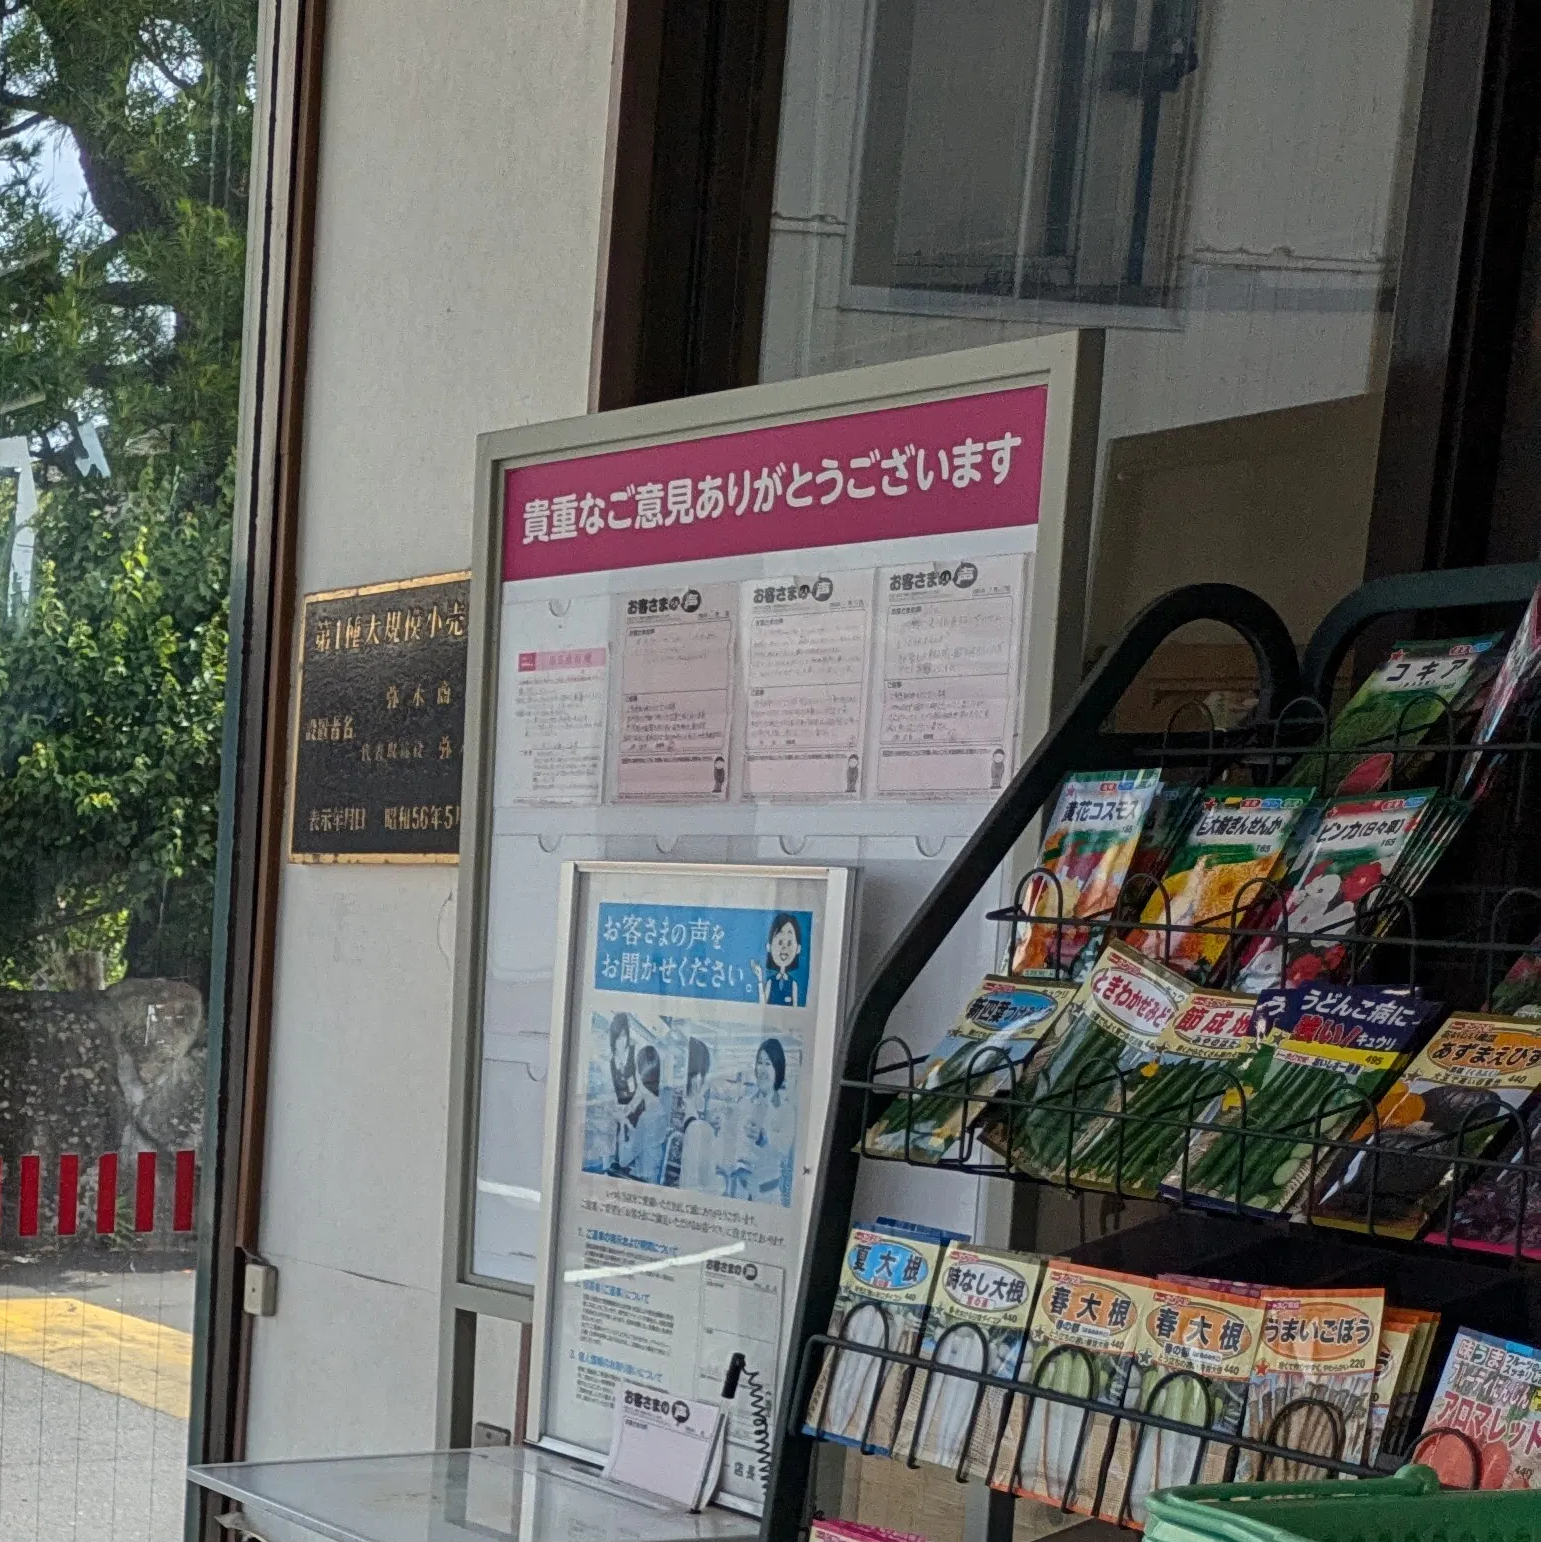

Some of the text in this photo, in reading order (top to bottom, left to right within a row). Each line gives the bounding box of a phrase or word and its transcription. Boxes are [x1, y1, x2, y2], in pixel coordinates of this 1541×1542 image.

[522, 431, 1021, 545] 貴重なご意見ありがとうございます
[753, 577, 833, 604] お客さまの声
[890, 562, 978, 591] お客さまの声
[628, 589, 702, 615] お客さまの声
[1387, 659, 1469, 682] コキア
[1061, 798, 1140, 823] 黄花コスモス
[603, 913, 725, 951] お客さまの声を
[602, 950, 753, 994] お聞かせください。
[1301, 990, 1414, 1027] うどんこ病に
[1356, 1036, 1398, 1050] キュウリ
[1432, 1042, 1541, 1068] あずまえびす
[1365, 1055, 1385, 1067] 495
[853, 1244, 922, 1283] 夏大根
[946, 1267, 1026, 1305] 時なし大根
[1051, 1285, 1132, 1328] 春大根
[1156, 1307, 1245, 1353] 春大根
[1264, 1317, 1371, 1344] うまいごぼう
[1224, 1364, 1240, 1375] 440
[1350, 1358, 1365, 1368] 220
[624, 1390, 690, 1423] お客さまの声
